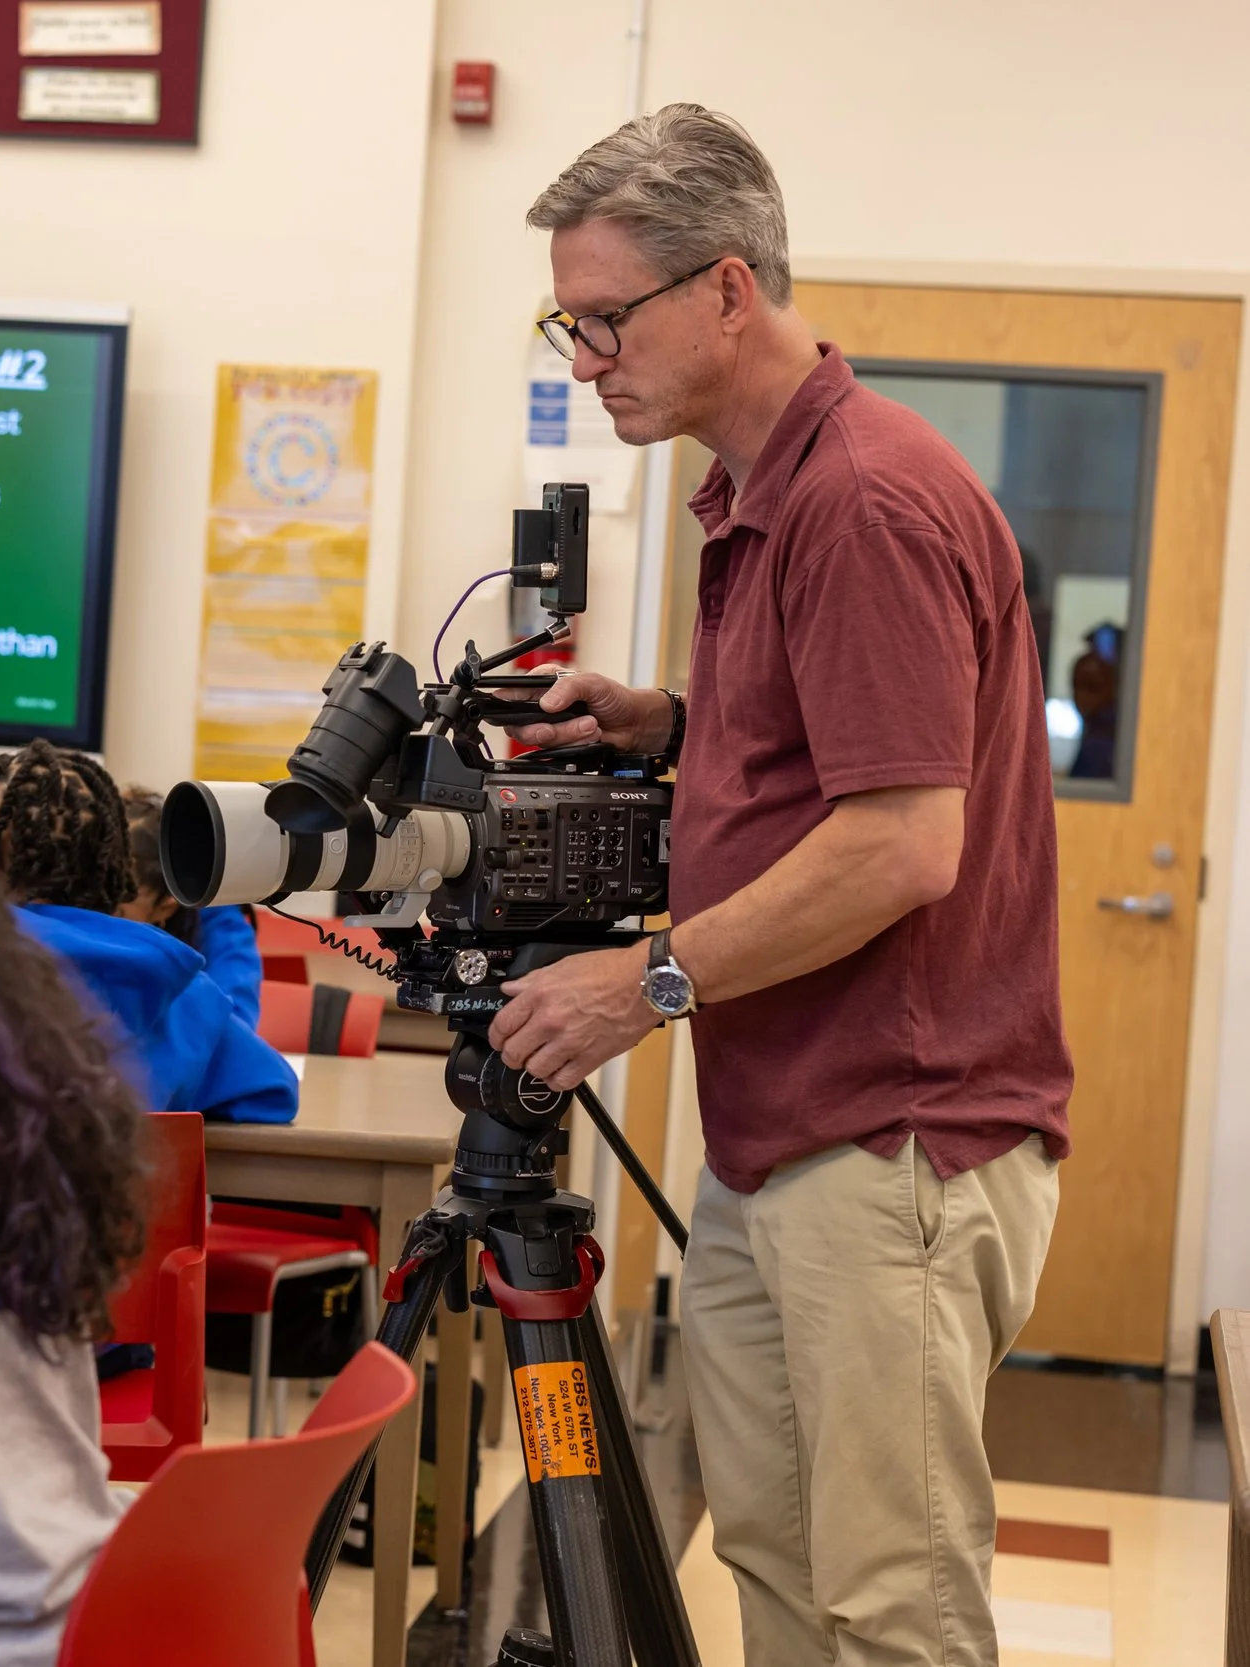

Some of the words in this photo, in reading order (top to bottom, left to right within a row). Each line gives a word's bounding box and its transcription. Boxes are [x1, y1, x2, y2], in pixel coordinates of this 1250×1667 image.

[610, 792, 648, 800] SONY
[447, 999, 470, 1012] CBS
[531, 1377, 540, 1402] New
[559, 1380, 570, 1400] 524
[571, 1368, 588, 1408] CBS
[534, 1405, 546, 1429] York
[562, 1402, 572, 1413] W
[546, 1394, 557, 1418] New
[552, 1421, 563, 1446] York
[564, 1416, 576, 1440] 57th
[568, 1443, 578, 1458] ST
[578, 1413, 597, 1469] NEWS
